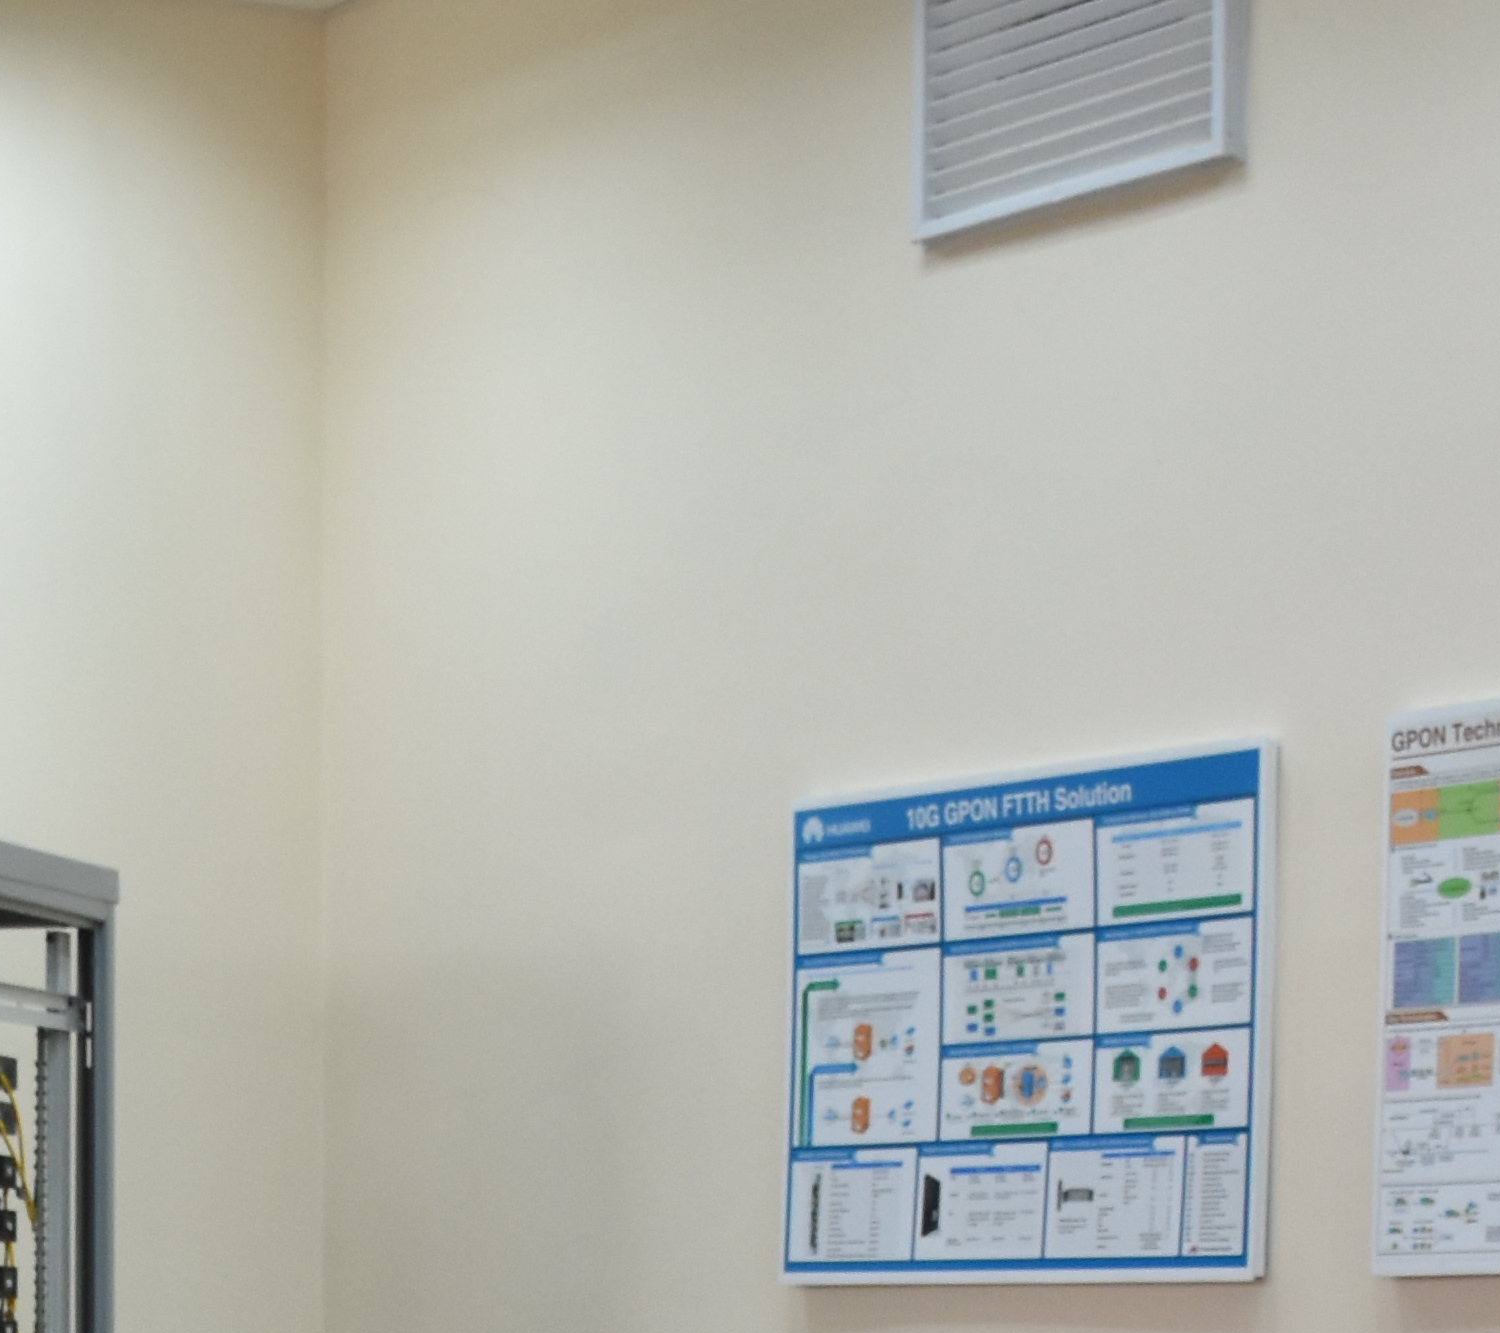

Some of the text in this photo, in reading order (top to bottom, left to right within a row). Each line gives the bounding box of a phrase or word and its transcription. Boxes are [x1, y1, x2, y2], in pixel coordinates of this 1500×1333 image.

[1391, 726, 1446, 752] GPON
[906, 782, 1133, 830] 10G GPON FTTH Solution
